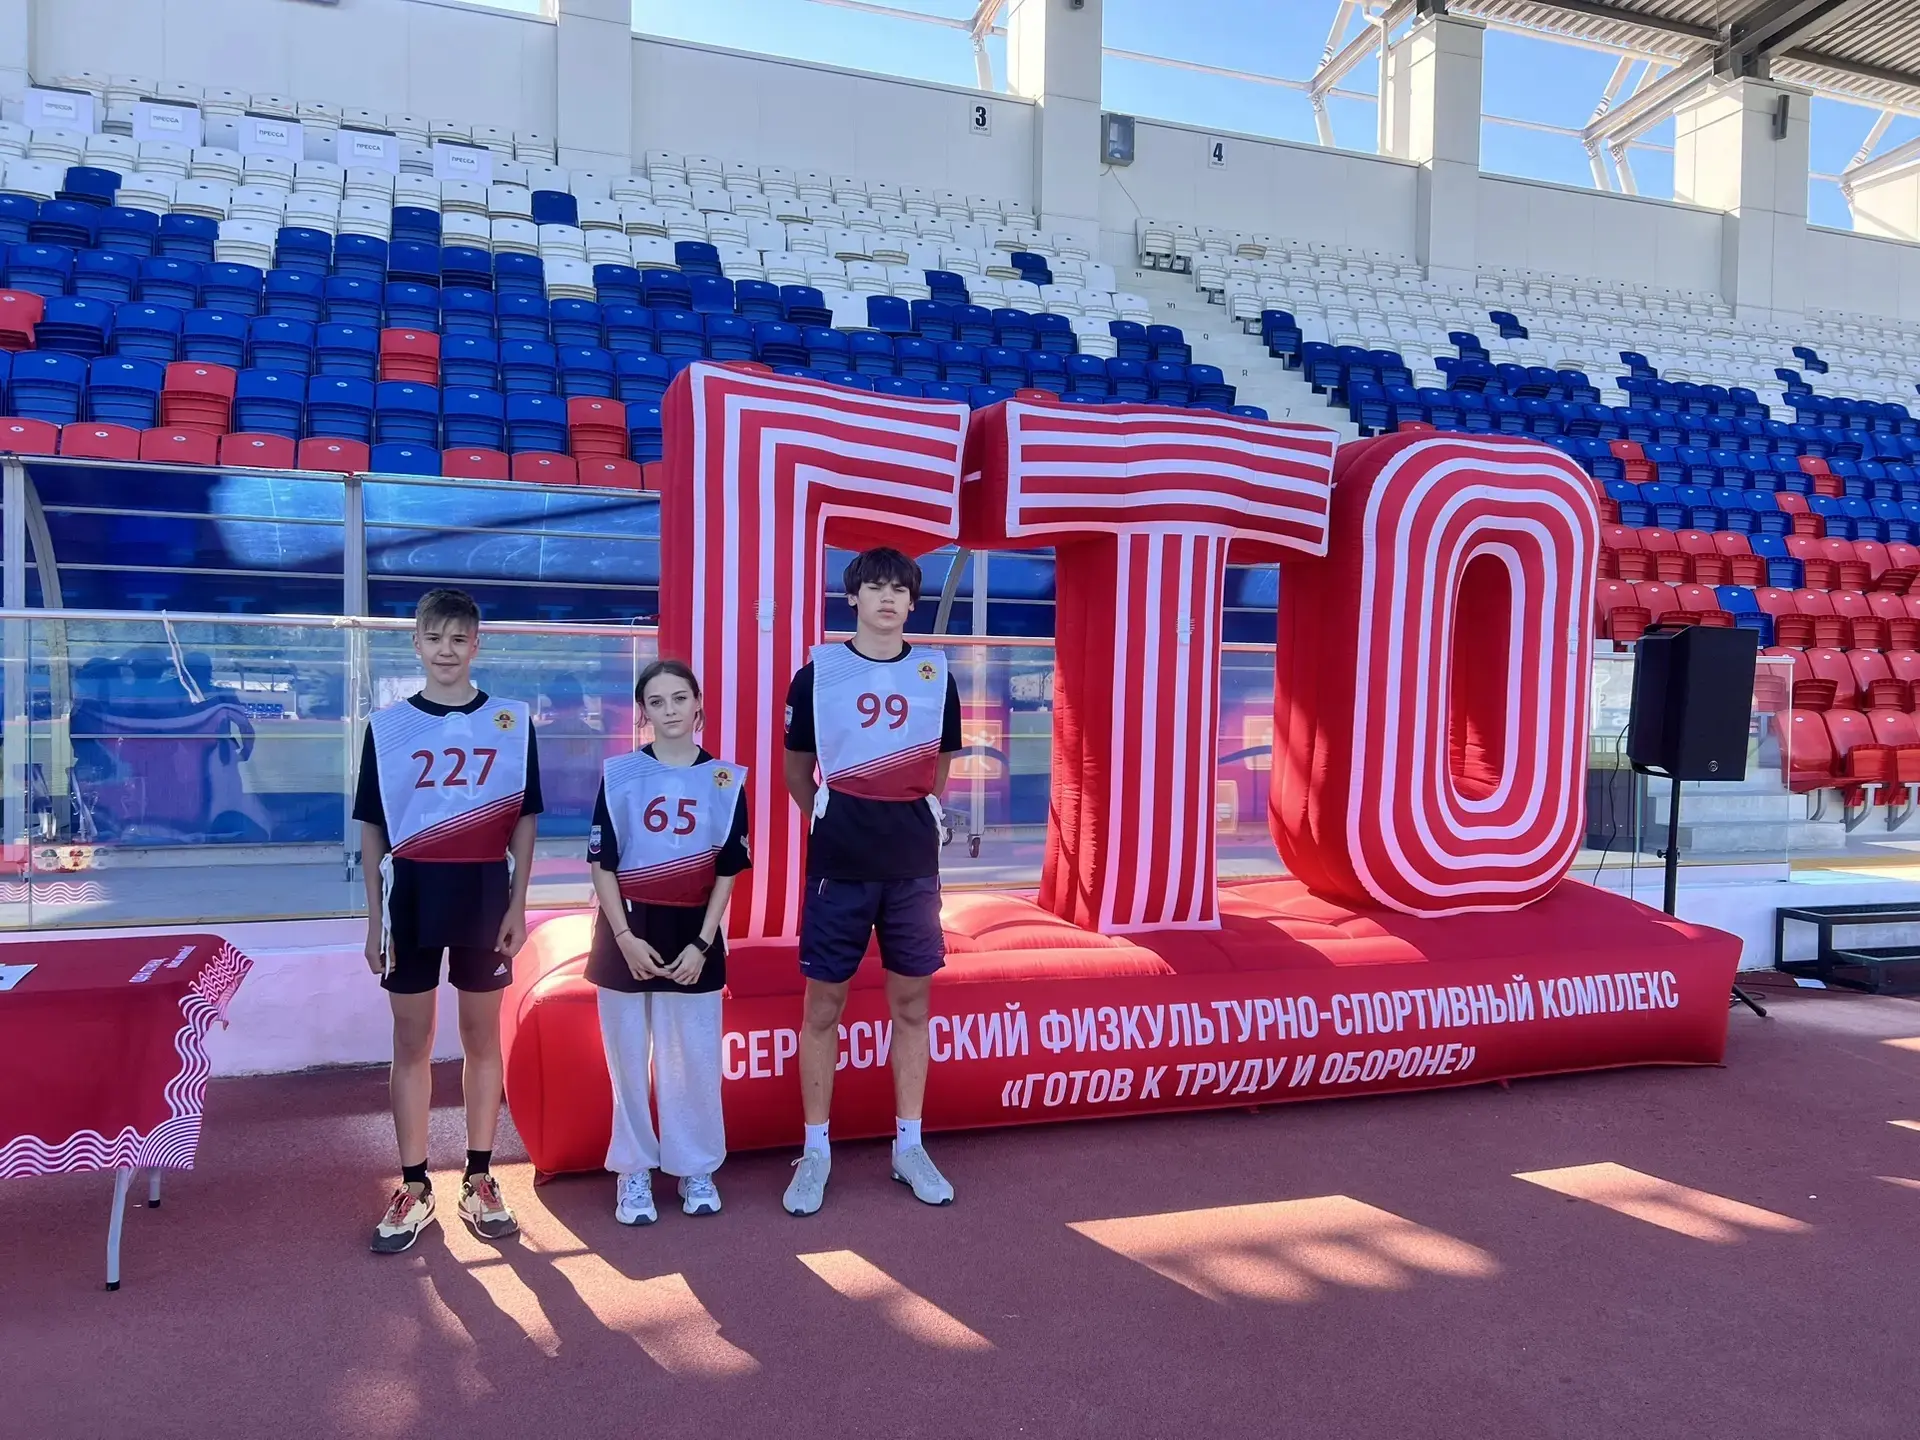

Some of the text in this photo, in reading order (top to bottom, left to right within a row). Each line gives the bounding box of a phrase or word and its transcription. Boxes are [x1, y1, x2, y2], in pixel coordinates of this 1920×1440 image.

[152, 114, 179, 124] ПРЕССА
[975, 106, 987, 127] 3
[258, 129, 285, 138] ПРЕССА
[356, 143, 381, 152] ПРЕССА
[1213, 142, 1224, 162] 4
[451, 156, 475, 165] ПРЕССА
[1285, 407, 1291, 417] 7
[658, 362, 1602, 947] ГТО
[856, 692, 909, 730] 99
[411, 747, 498, 789] 227
[643, 795, 697, 835] 65
[1039, 974, 1535, 1054] ФИЗКУЛЬТУРНО-СПОРТИВНЫЙ
[1537, 970, 1679, 1020] КОМПЛЕКС
[1001, 1043, 1476, 1109] «ГОТОВ К ТРУДУ И ОБОРОНЕ»
